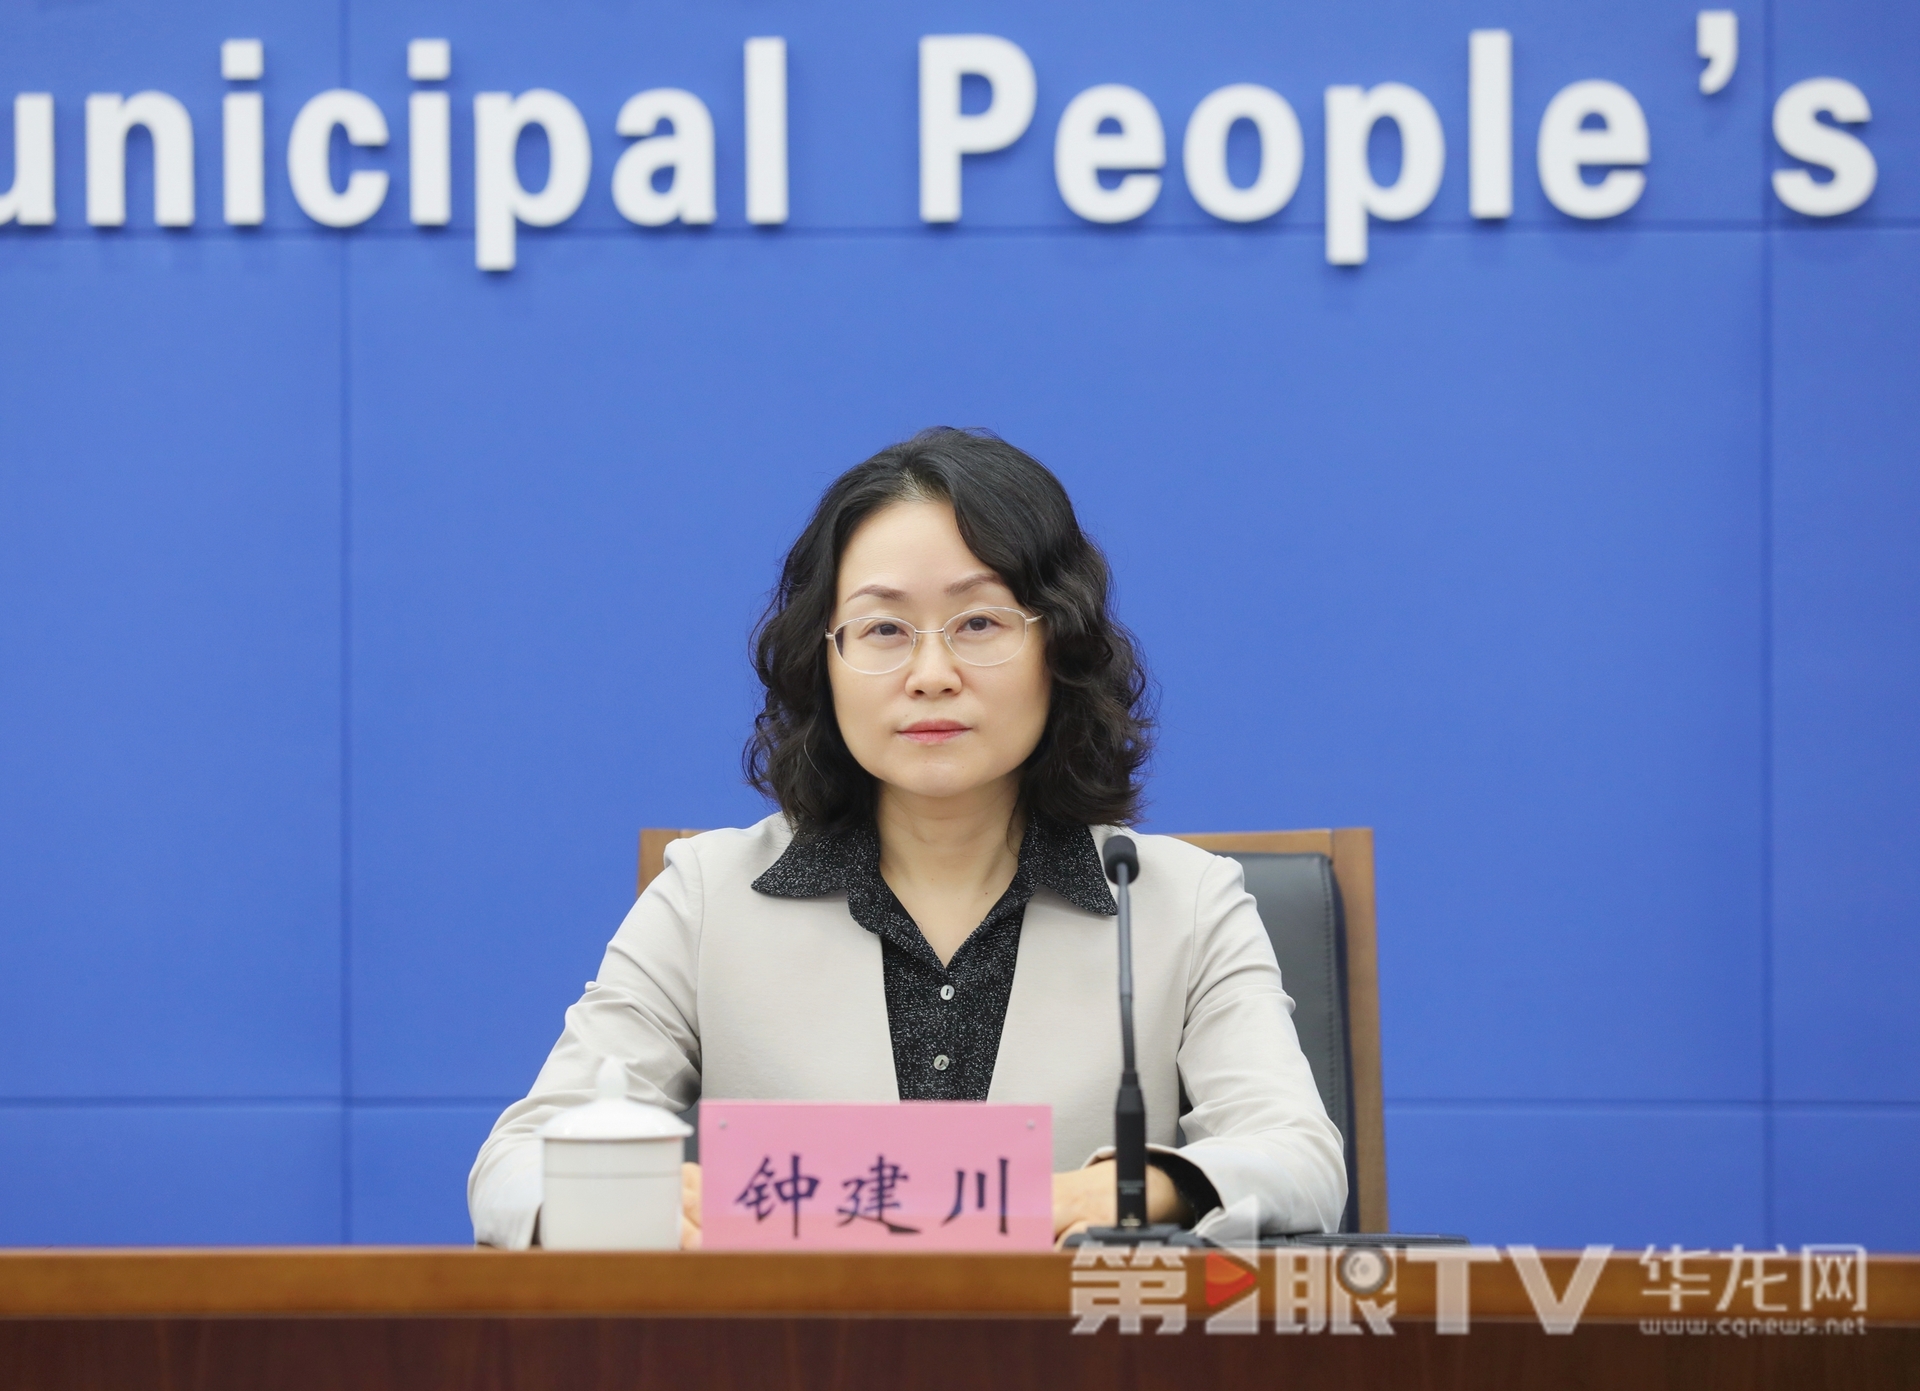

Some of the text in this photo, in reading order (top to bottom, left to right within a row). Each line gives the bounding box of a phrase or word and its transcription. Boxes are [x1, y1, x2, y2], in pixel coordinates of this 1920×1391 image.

[918, 9, 1878, 267] People’s
[734, 1153, 1009, 1240] 钟建川
